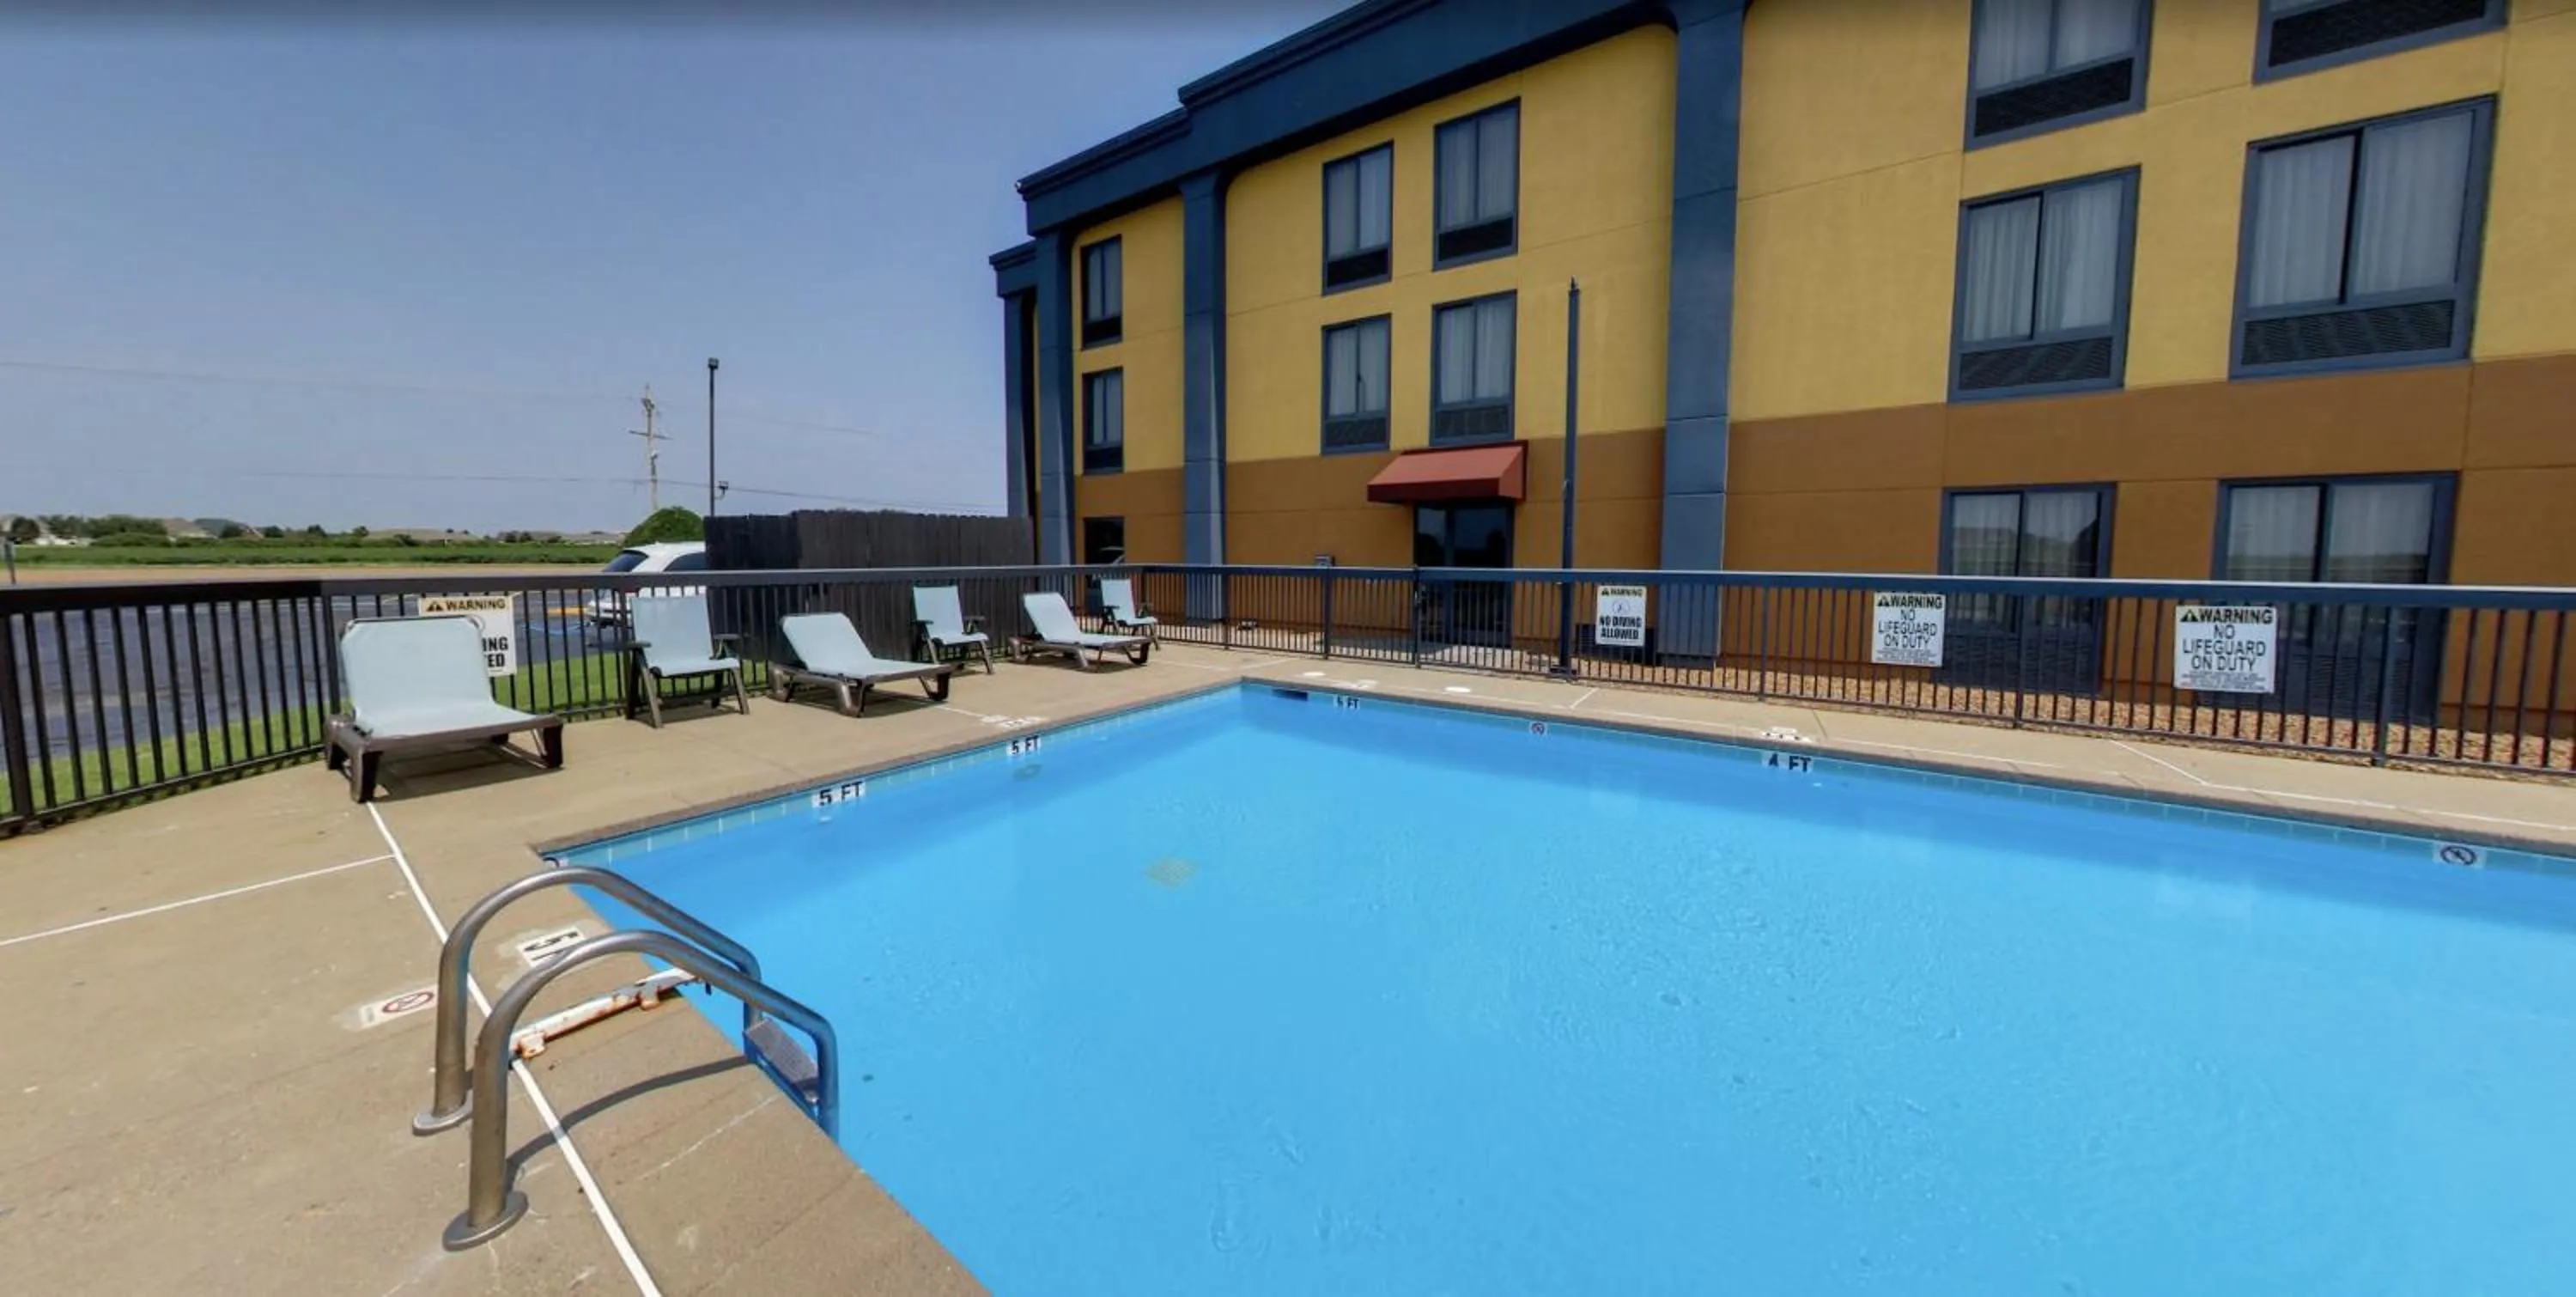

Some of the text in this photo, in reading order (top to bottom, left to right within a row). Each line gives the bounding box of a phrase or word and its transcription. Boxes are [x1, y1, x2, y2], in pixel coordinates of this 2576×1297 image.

[445, 599, 506, 612] WARNING
[1891, 594, 1942, 609] WARNING
[1600, 615, 1612, 626] NO
[1900, 609, 1916, 621] NO
[2198, 608, 2273, 624] WARNING
[1601, 627, 1639, 640] ALLOWED
[1878, 620, 1938, 636] LIFEGUARD
[2214, 624, 2235, 639] NO
[1884, 634, 1930, 648] ON DUTY
[2183, 638, 2266, 657] LIFEGUARD
[2191, 655, 2256, 671] ON DUTY
[1347, 697, 1360, 709] FT
[1012, 735, 1040, 754] 5 FT
[1768, 752, 1812, 773] 4 FT
[819, 781, 863, 807] 5 FT
